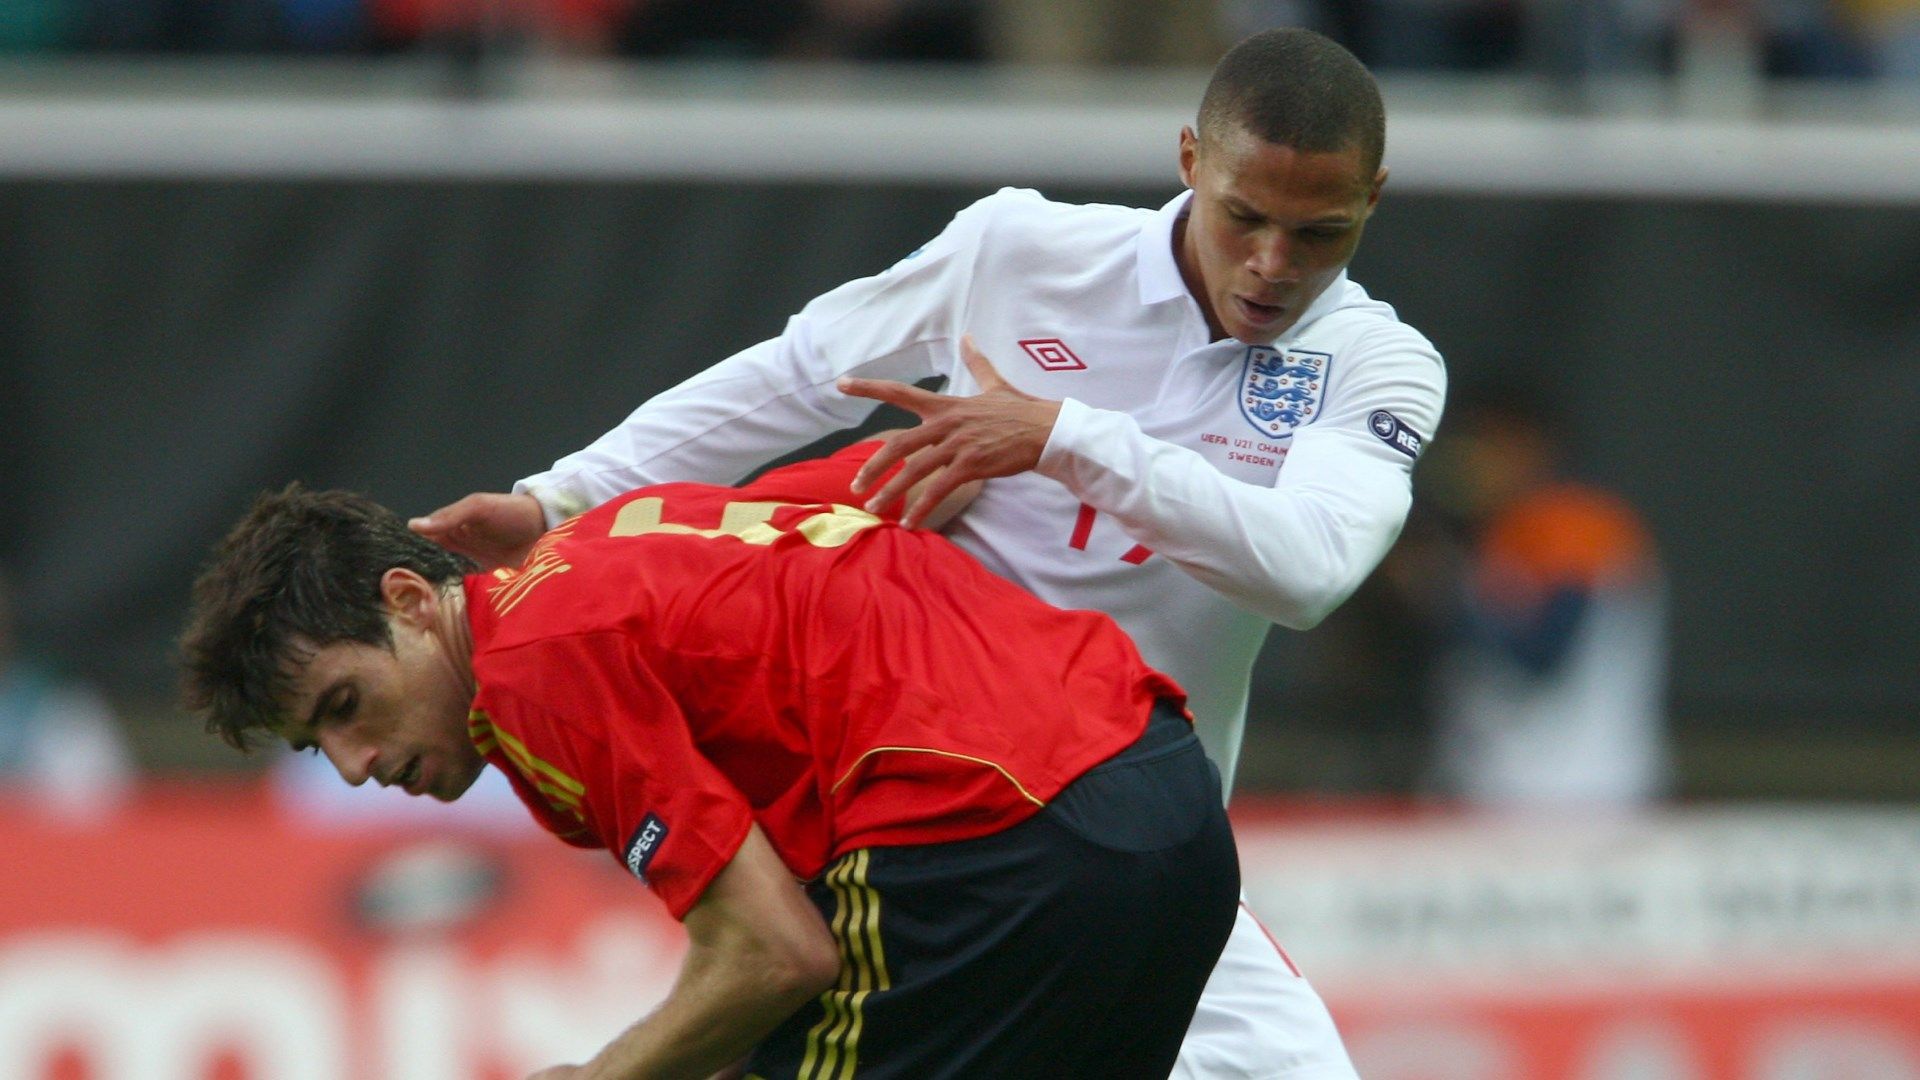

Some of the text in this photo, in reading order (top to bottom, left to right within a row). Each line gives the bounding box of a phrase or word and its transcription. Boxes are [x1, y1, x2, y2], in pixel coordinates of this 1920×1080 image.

[1201, 433, 1228, 446] UEFA
[1234, 439, 1252, 449] U21
[1228, 451, 1275, 467] SWEDEN
[627, 820, 661, 878] SPECT
